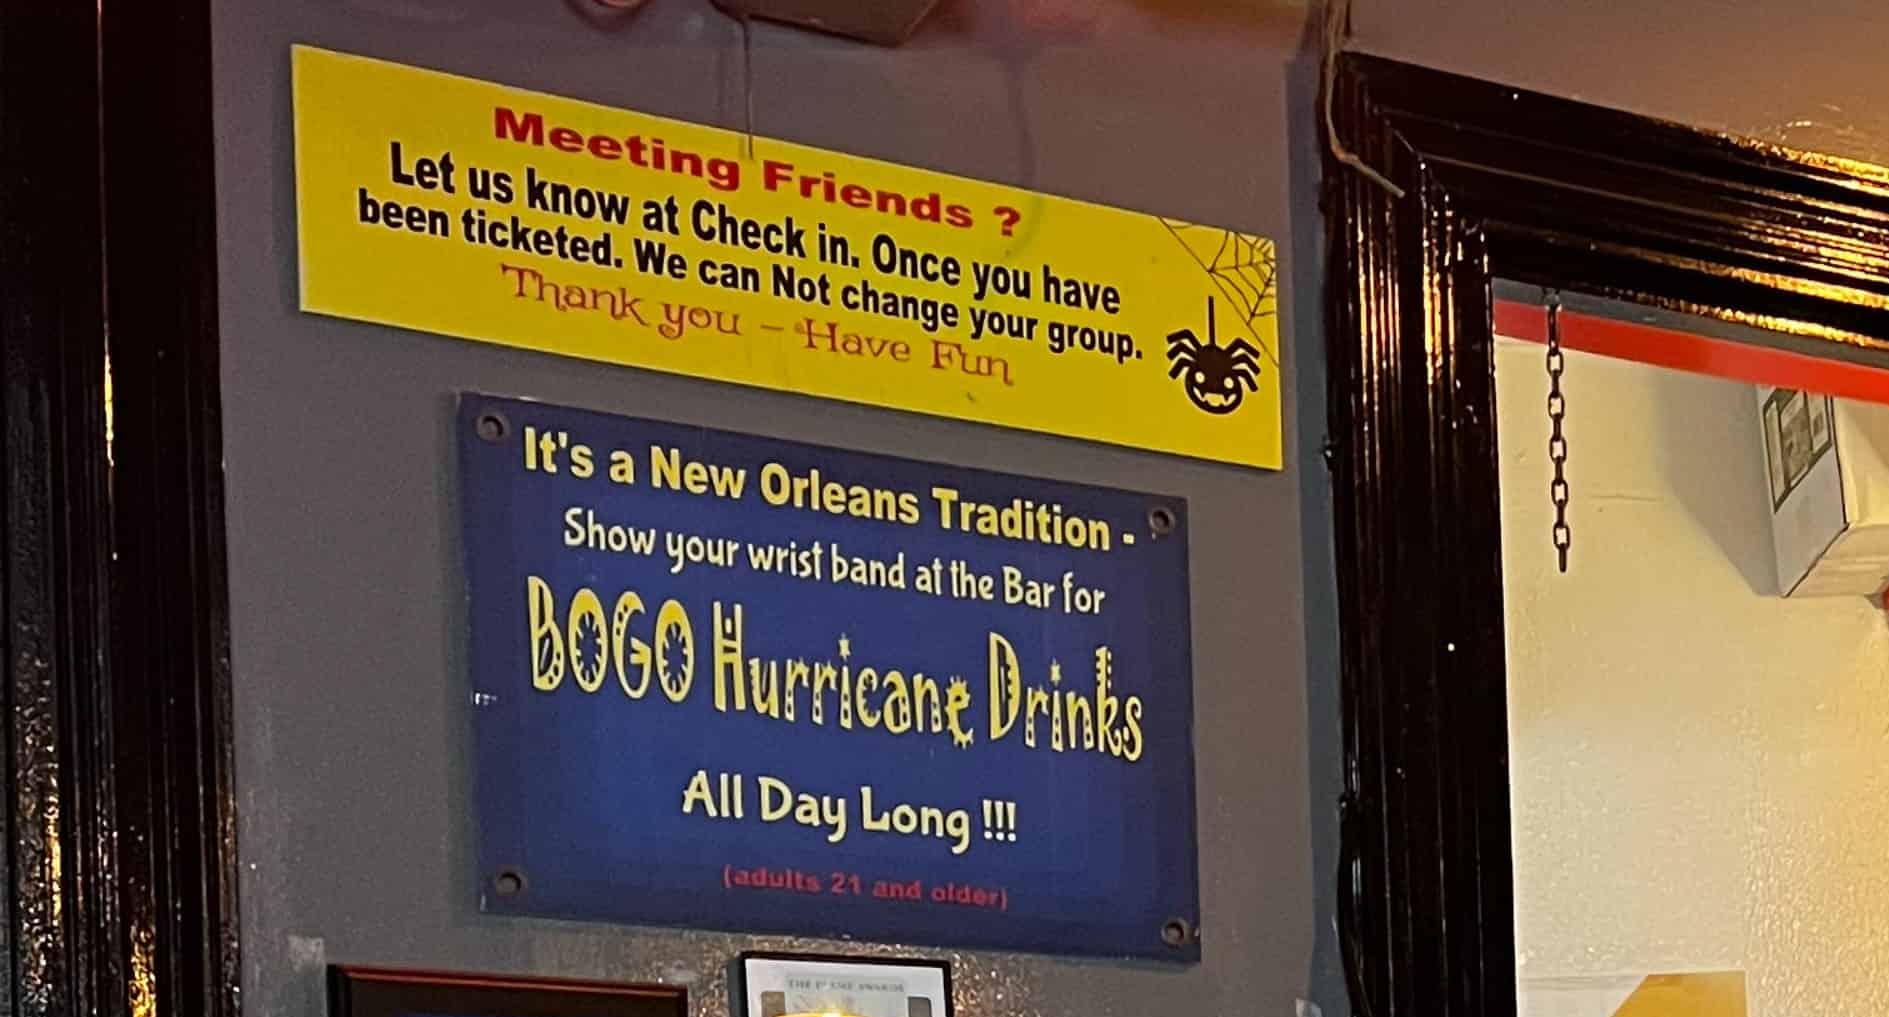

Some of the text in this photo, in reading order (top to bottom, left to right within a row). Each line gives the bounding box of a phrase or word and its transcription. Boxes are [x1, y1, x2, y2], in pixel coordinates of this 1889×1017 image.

[390, 142, 1121, 314] Let us know at Check in. Once you have
[494, 107, 1022, 237] Meeting Friends ?
[358, 188, 1143, 365] been ticketed. We can Not change your group.
[500, 264, 649, 326] Thank
[657, 303, 742, 340] you
[794, 318, 910, 363] Have
[930, 340, 1015, 386] Fun
[525, 426, 1136, 551] It's a New Orleans Tradition -
[564, 506, 1105, 614] Show your wrist band at the Bar for
[527, 575, 1143, 762] BOGO Hurricane Drinks
[681, 769, 1018, 855] All Day Long !!!
[722, 864, 1009, 911] (adults 21 and older)
